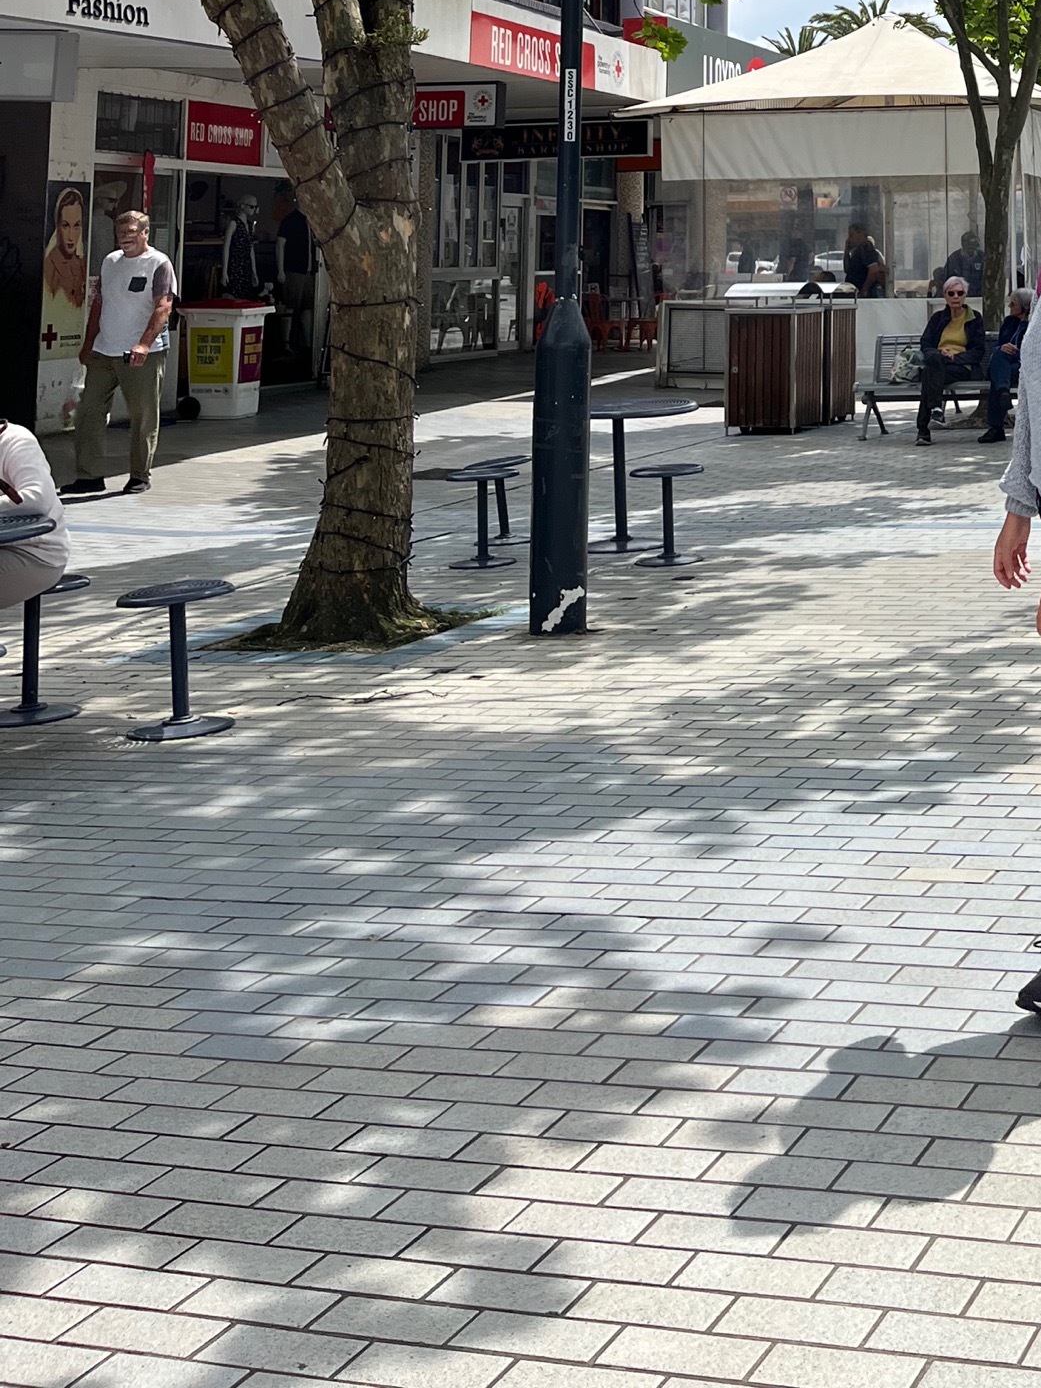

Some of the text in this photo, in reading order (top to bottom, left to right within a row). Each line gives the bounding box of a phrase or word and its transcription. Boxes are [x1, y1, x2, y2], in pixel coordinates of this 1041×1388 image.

[491, 25, 513, 66] RED
[516, 32, 551, 76] CROSS
[419, 99, 458, 122] SHOP
[566, 70, 574, 141] SSC1230
[190, 121, 254, 147] RED CROSS SHOP
[521, 125, 622, 144] INFITY
